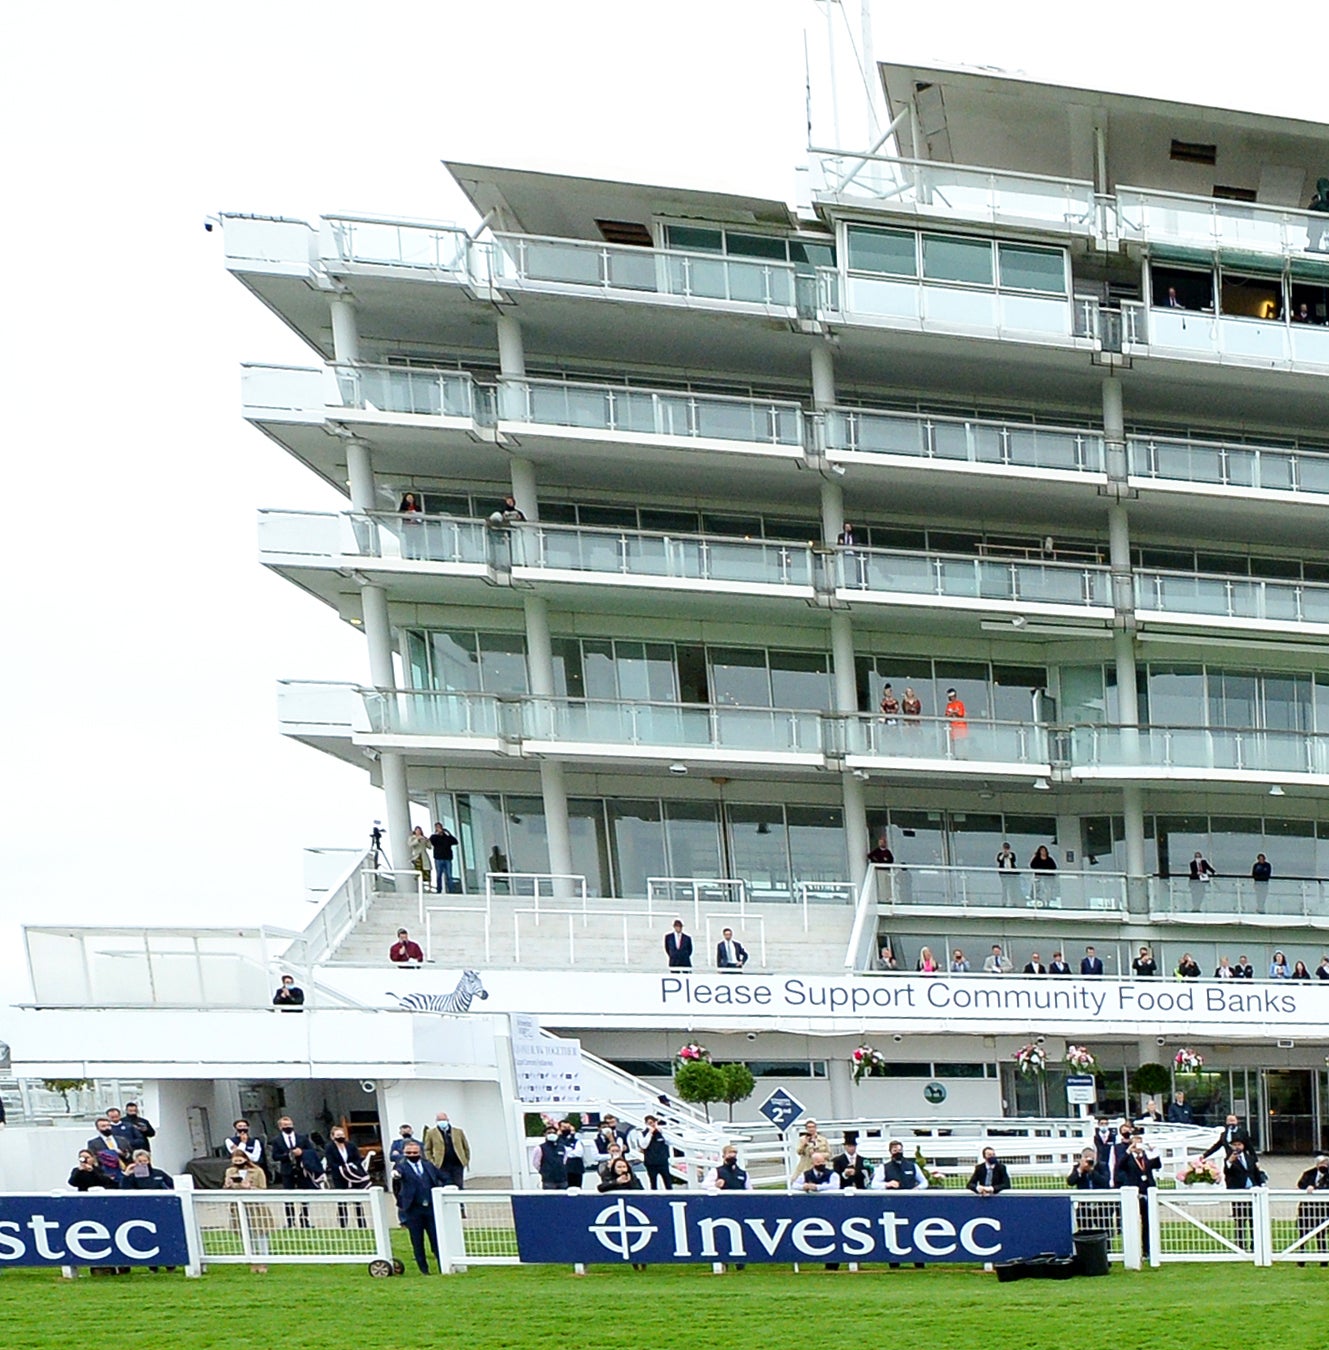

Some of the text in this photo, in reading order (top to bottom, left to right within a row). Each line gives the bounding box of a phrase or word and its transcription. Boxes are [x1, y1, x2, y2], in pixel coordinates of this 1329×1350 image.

[660, 977, 1296, 1016] Please Support Community Food Banks
[668, 1201, 1002, 1257] Investec
